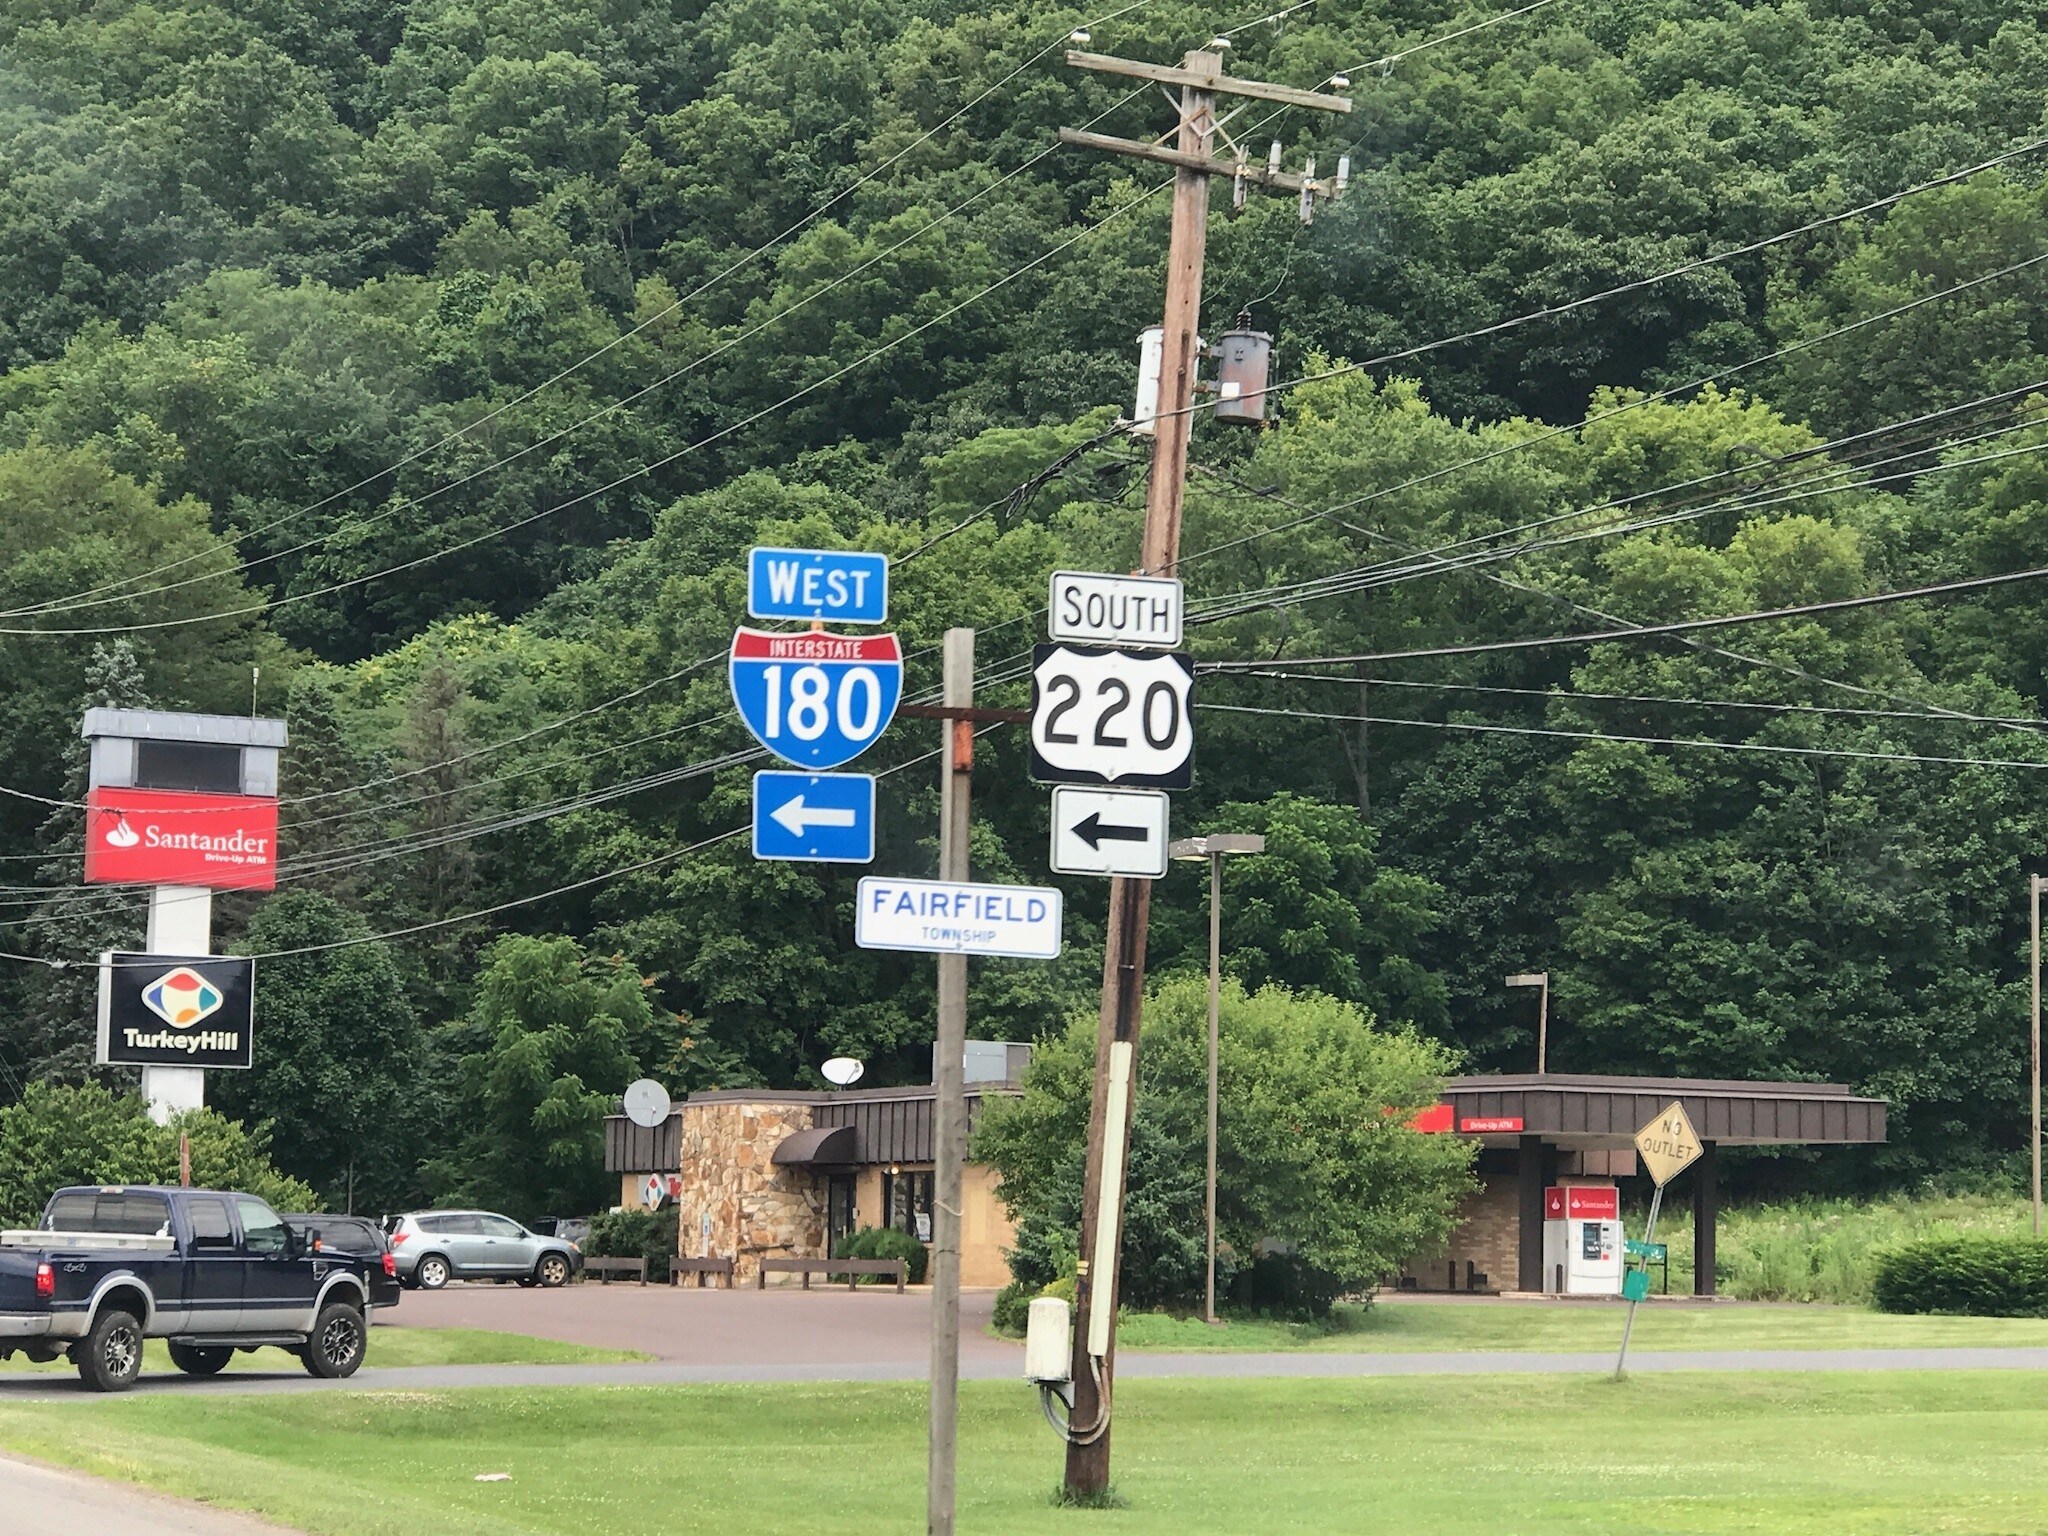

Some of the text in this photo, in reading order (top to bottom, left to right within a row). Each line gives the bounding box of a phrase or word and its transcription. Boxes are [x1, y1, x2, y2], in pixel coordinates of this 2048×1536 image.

[768, 560, 871, 609] WEST
[1063, 585, 1170, 633] SOUTH
[770, 638, 862, 660] INTERSTATE
[762, 665, 882, 741] 180
[1044, 674, 1180, 751] 220
[145, 825, 268, 853] Santander
[205, 853, 266, 864] Drive-Up ATM
[873, 889, 1047, 923] FAIRFIELD
[922, 926, 997, 943] TOWNSHIP
[1662, 1119, 1682, 1136] NO
[1643, 1138, 1693, 1160] OUTLET
[1581, 1200, 1615, 1209] Santander
